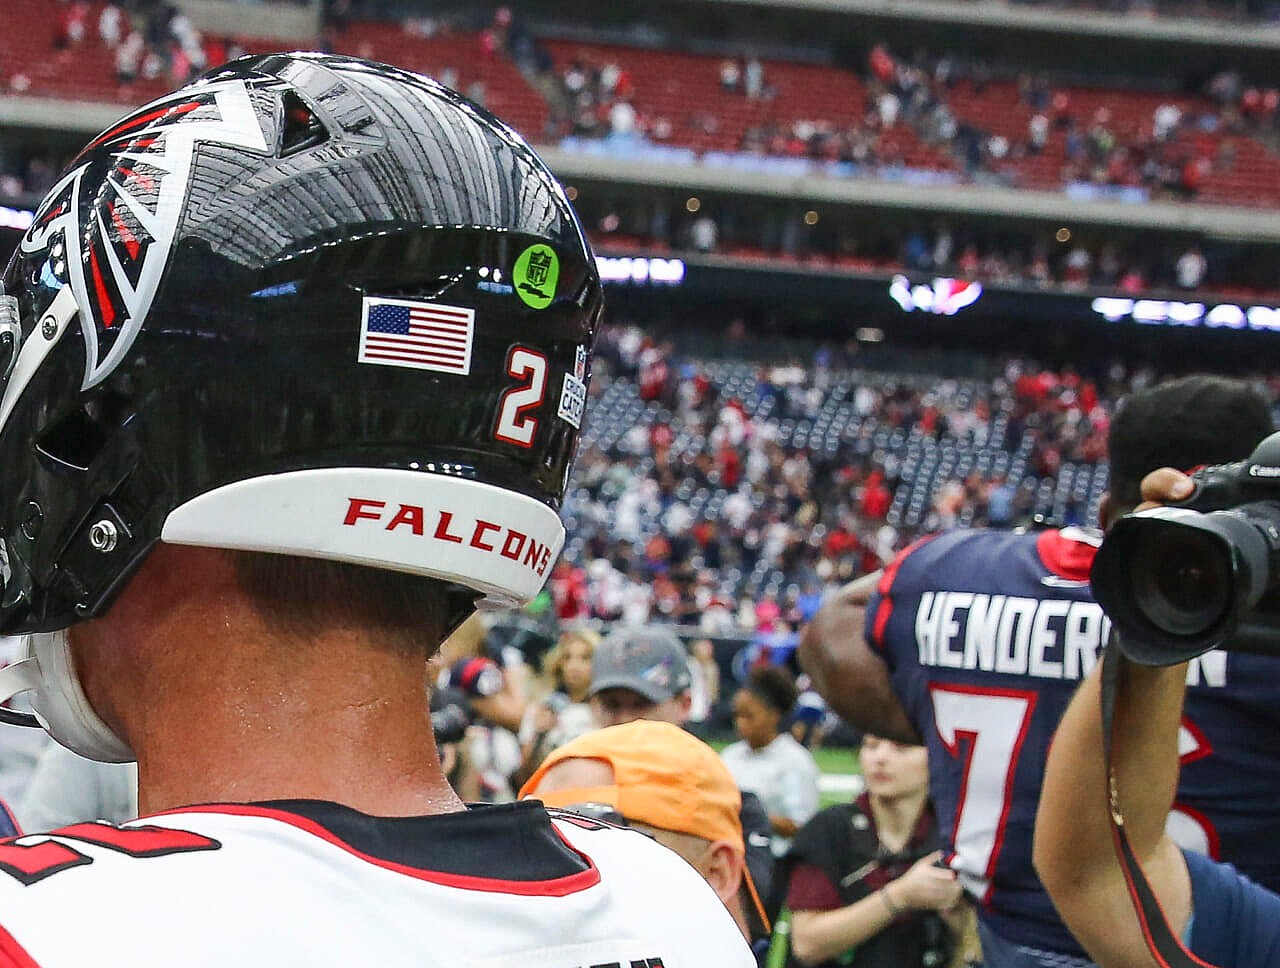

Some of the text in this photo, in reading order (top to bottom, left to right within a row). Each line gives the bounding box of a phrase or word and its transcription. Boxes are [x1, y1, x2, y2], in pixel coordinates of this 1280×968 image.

[494, 346, 549, 448] 2
[343, 497, 551, 577] FALCONS
[915, 591, 1228, 688] HENDER
